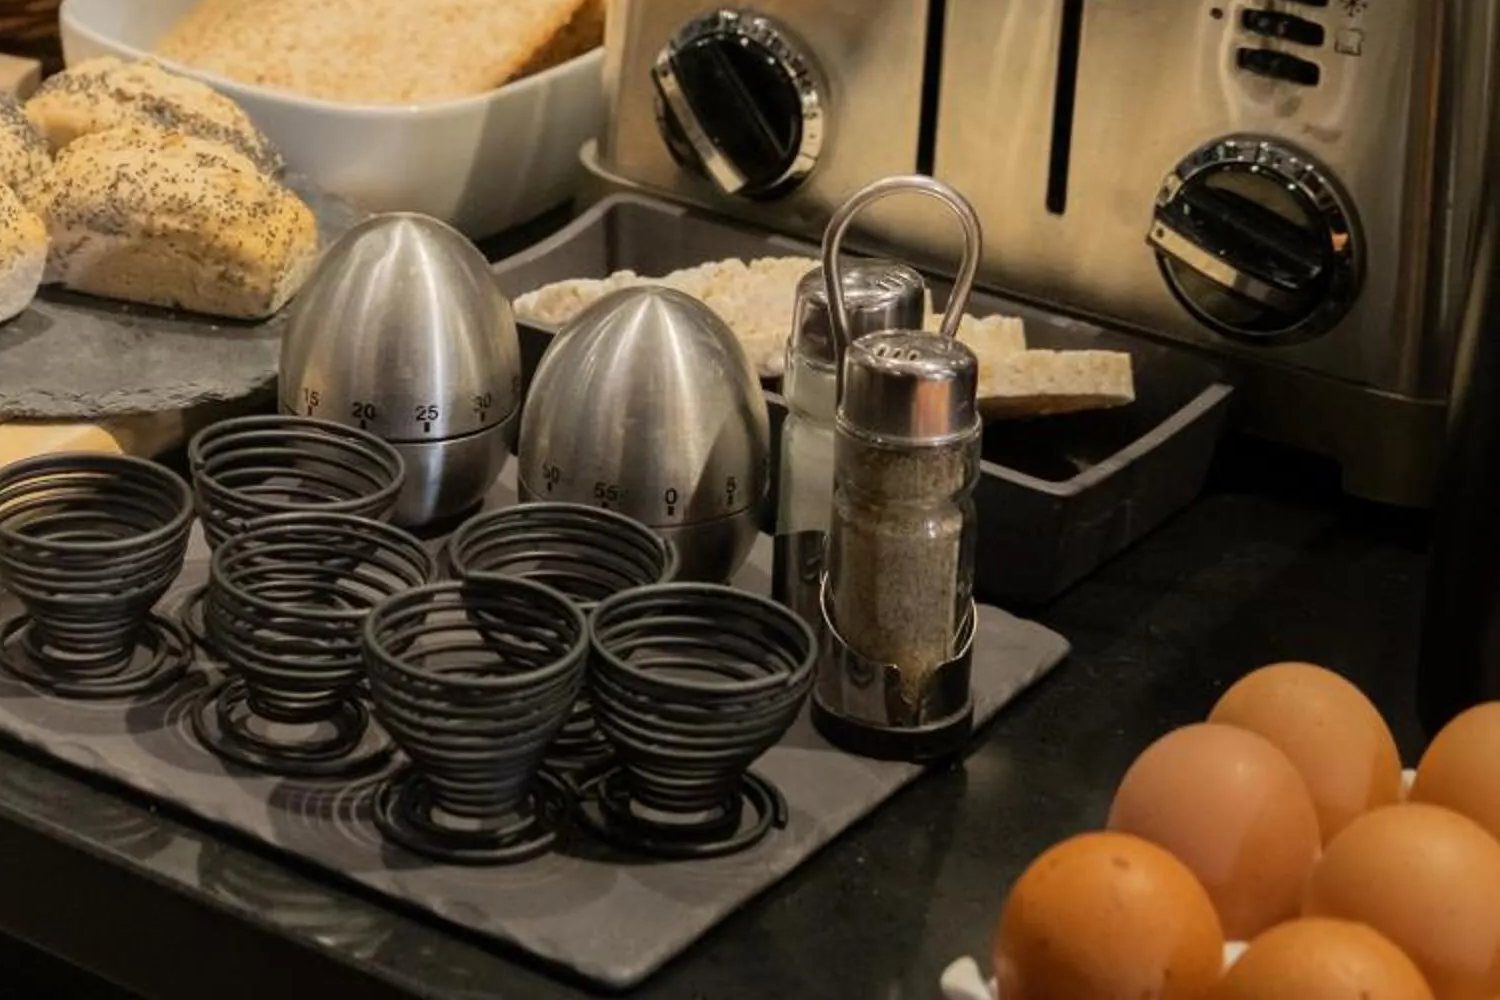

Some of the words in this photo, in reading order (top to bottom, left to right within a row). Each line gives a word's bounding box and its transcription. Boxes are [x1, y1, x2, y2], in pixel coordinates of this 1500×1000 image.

[303, 387, 320, 407] 15
[352, 401, 376, 420] 20
[415, 404, 439, 421] 25
[594, 481, 620, 501] 55
[665, 487, 678, 505] 0
